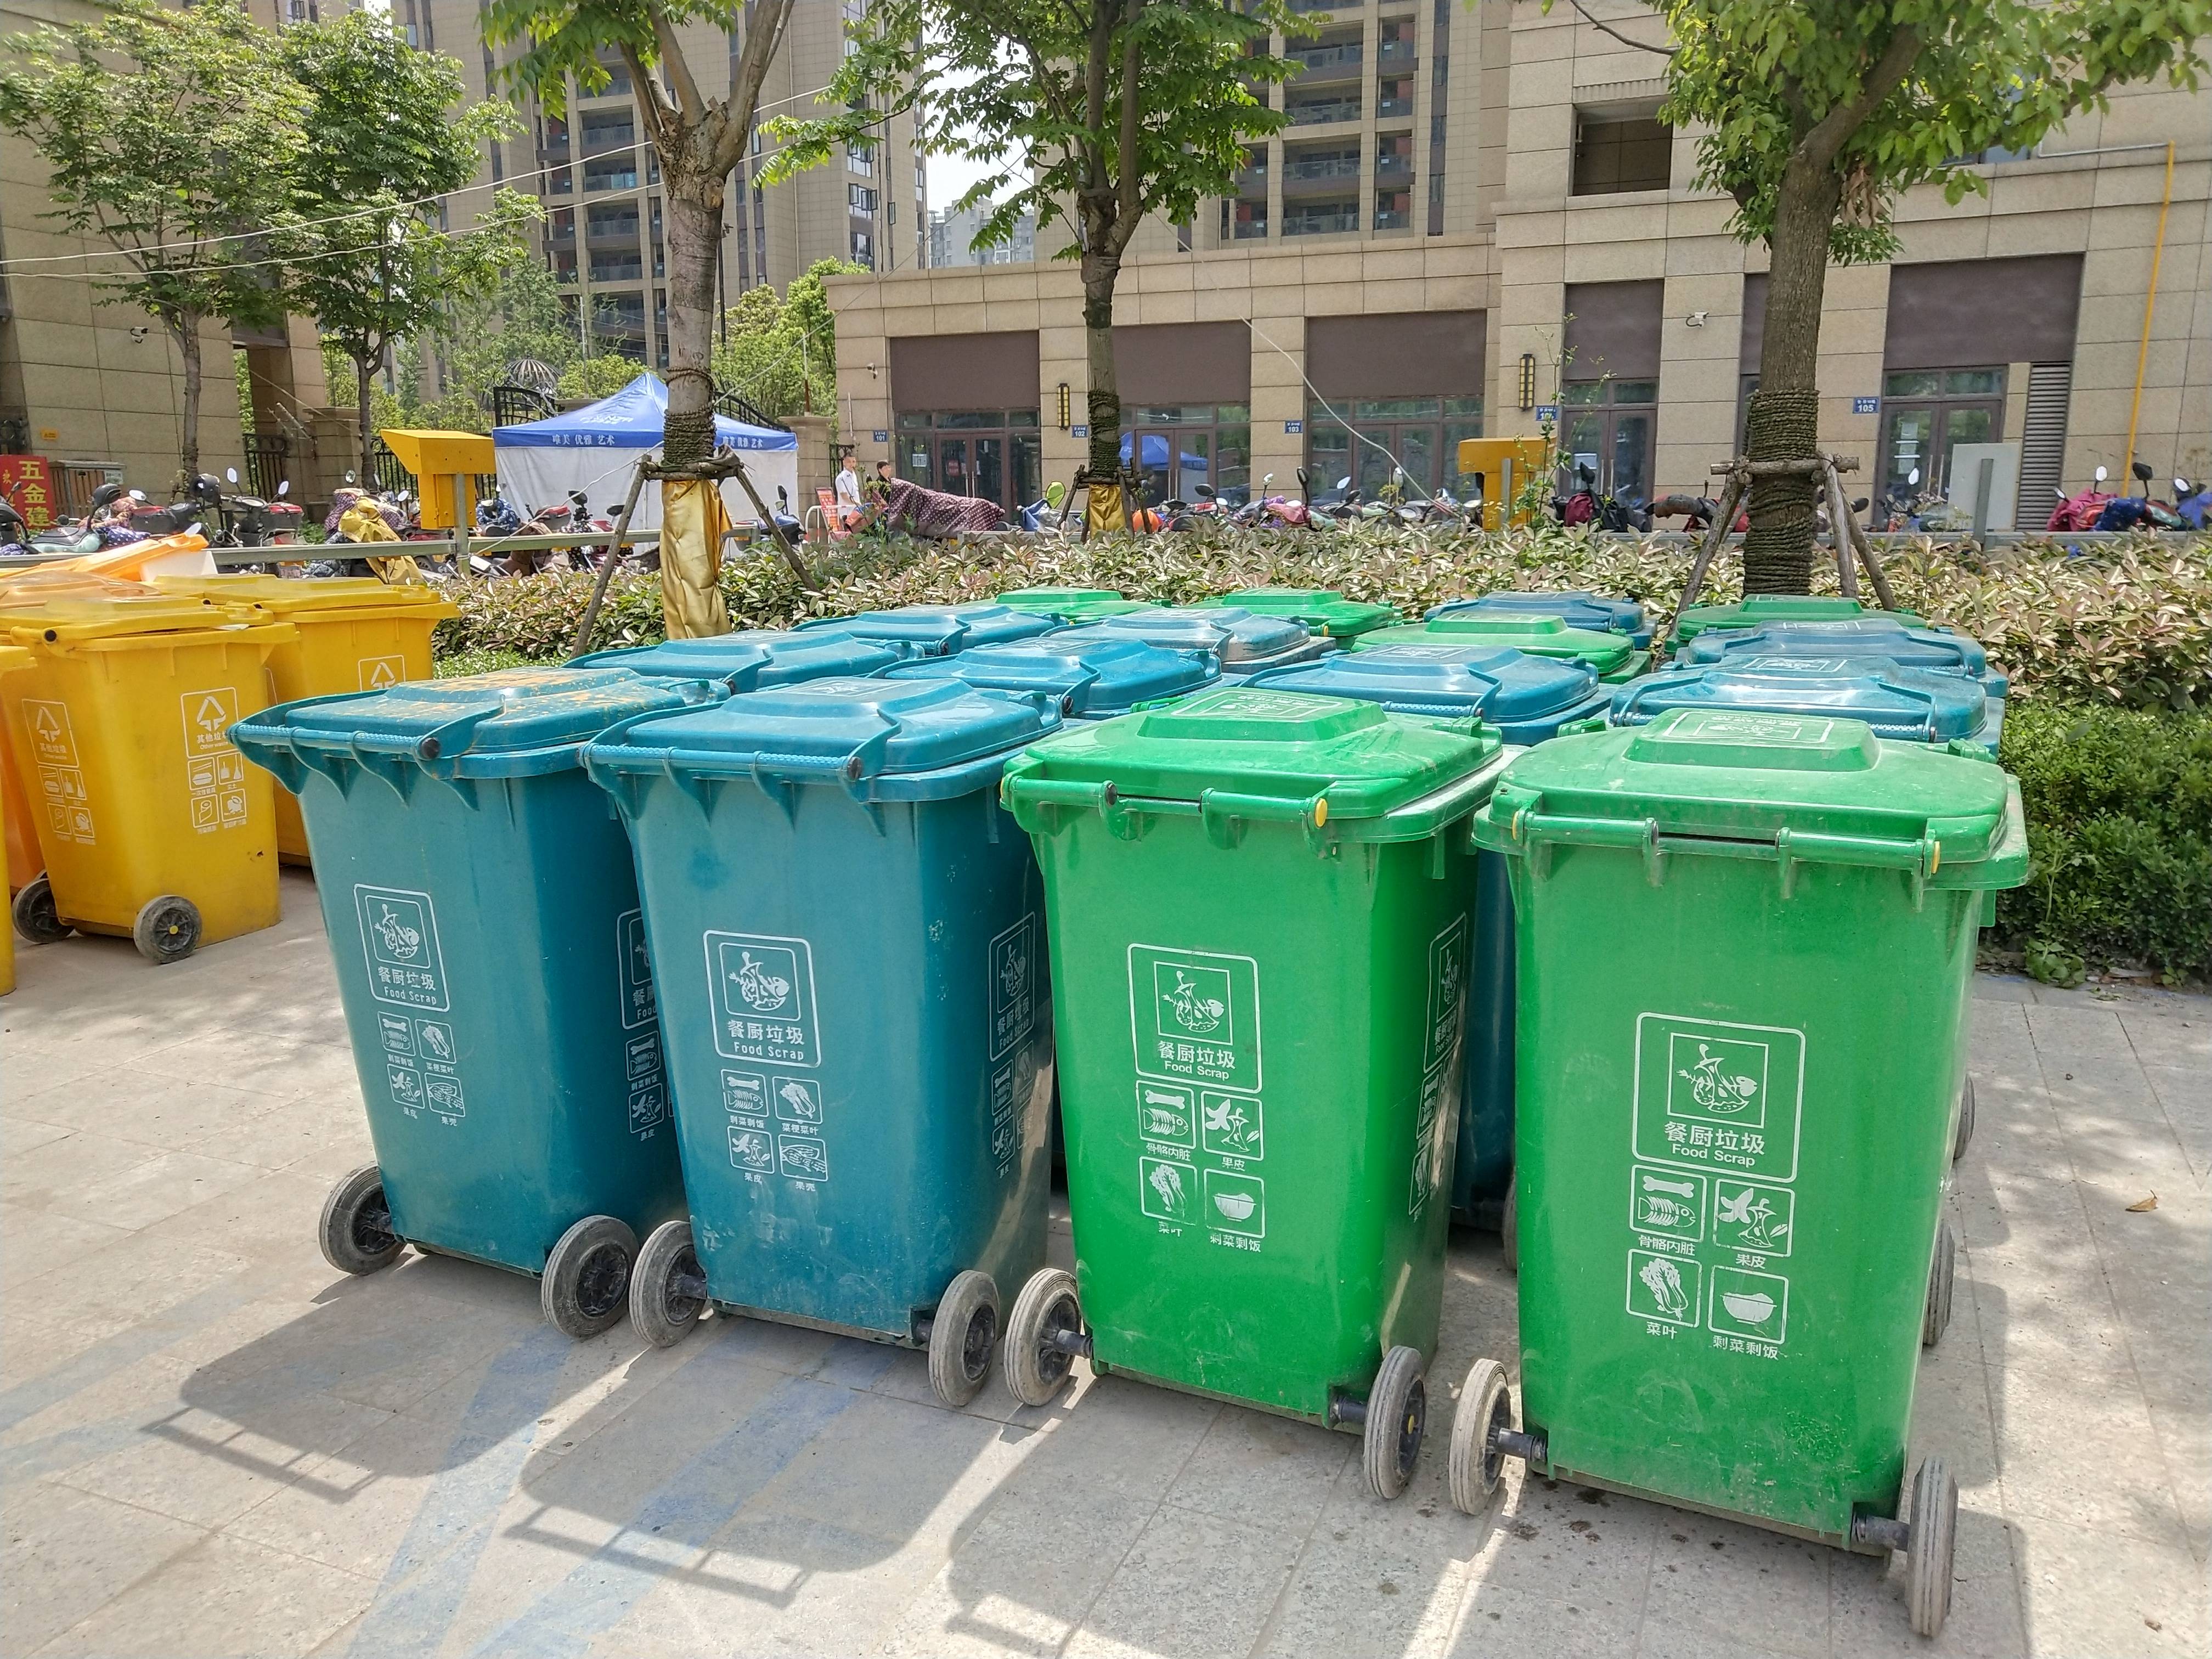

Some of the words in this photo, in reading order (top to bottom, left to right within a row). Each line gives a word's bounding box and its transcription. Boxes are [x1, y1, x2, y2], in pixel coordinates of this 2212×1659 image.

[575, 434, 592, 445] 优雅
[597, 435, 615, 445] 艺术
[377, 966, 436, 991] 餐厨垃圾
[384, 986, 406, 1000] Food
[409, 991, 437, 1005] Scrap
[997, 996, 1029, 1036] 餐厨垃圾
[727, 1019, 805, 1045] 餐厨垃圾
[733, 1041, 763, 1056] Food
[768, 1046, 804, 1061] Scrap
[1158, 1040, 1236, 1069] 餐厨垃圾
[1164, 1060, 1193, 1074] Food
[1197, 1065, 1229, 1081] Scrap
[1664, 1121, 1765, 1155] 餐厨垃圾
[1221, 1156, 1245, 1172] 果皮
[1672, 1143, 1708, 1159] Food
[1713, 1149, 1756, 1168] Scrap
[743, 1172, 763, 1186] 果皮
[1209, 1232, 1262, 1253] 剩菜剩饭
[1638, 1234, 1696, 1256] 骨骼内脏
[1735, 1253, 1767, 1269] 果皮
[1646, 1321, 1678, 1340] 菜叶
[1712, 1335, 1779, 1361] 剩菜剩饭
